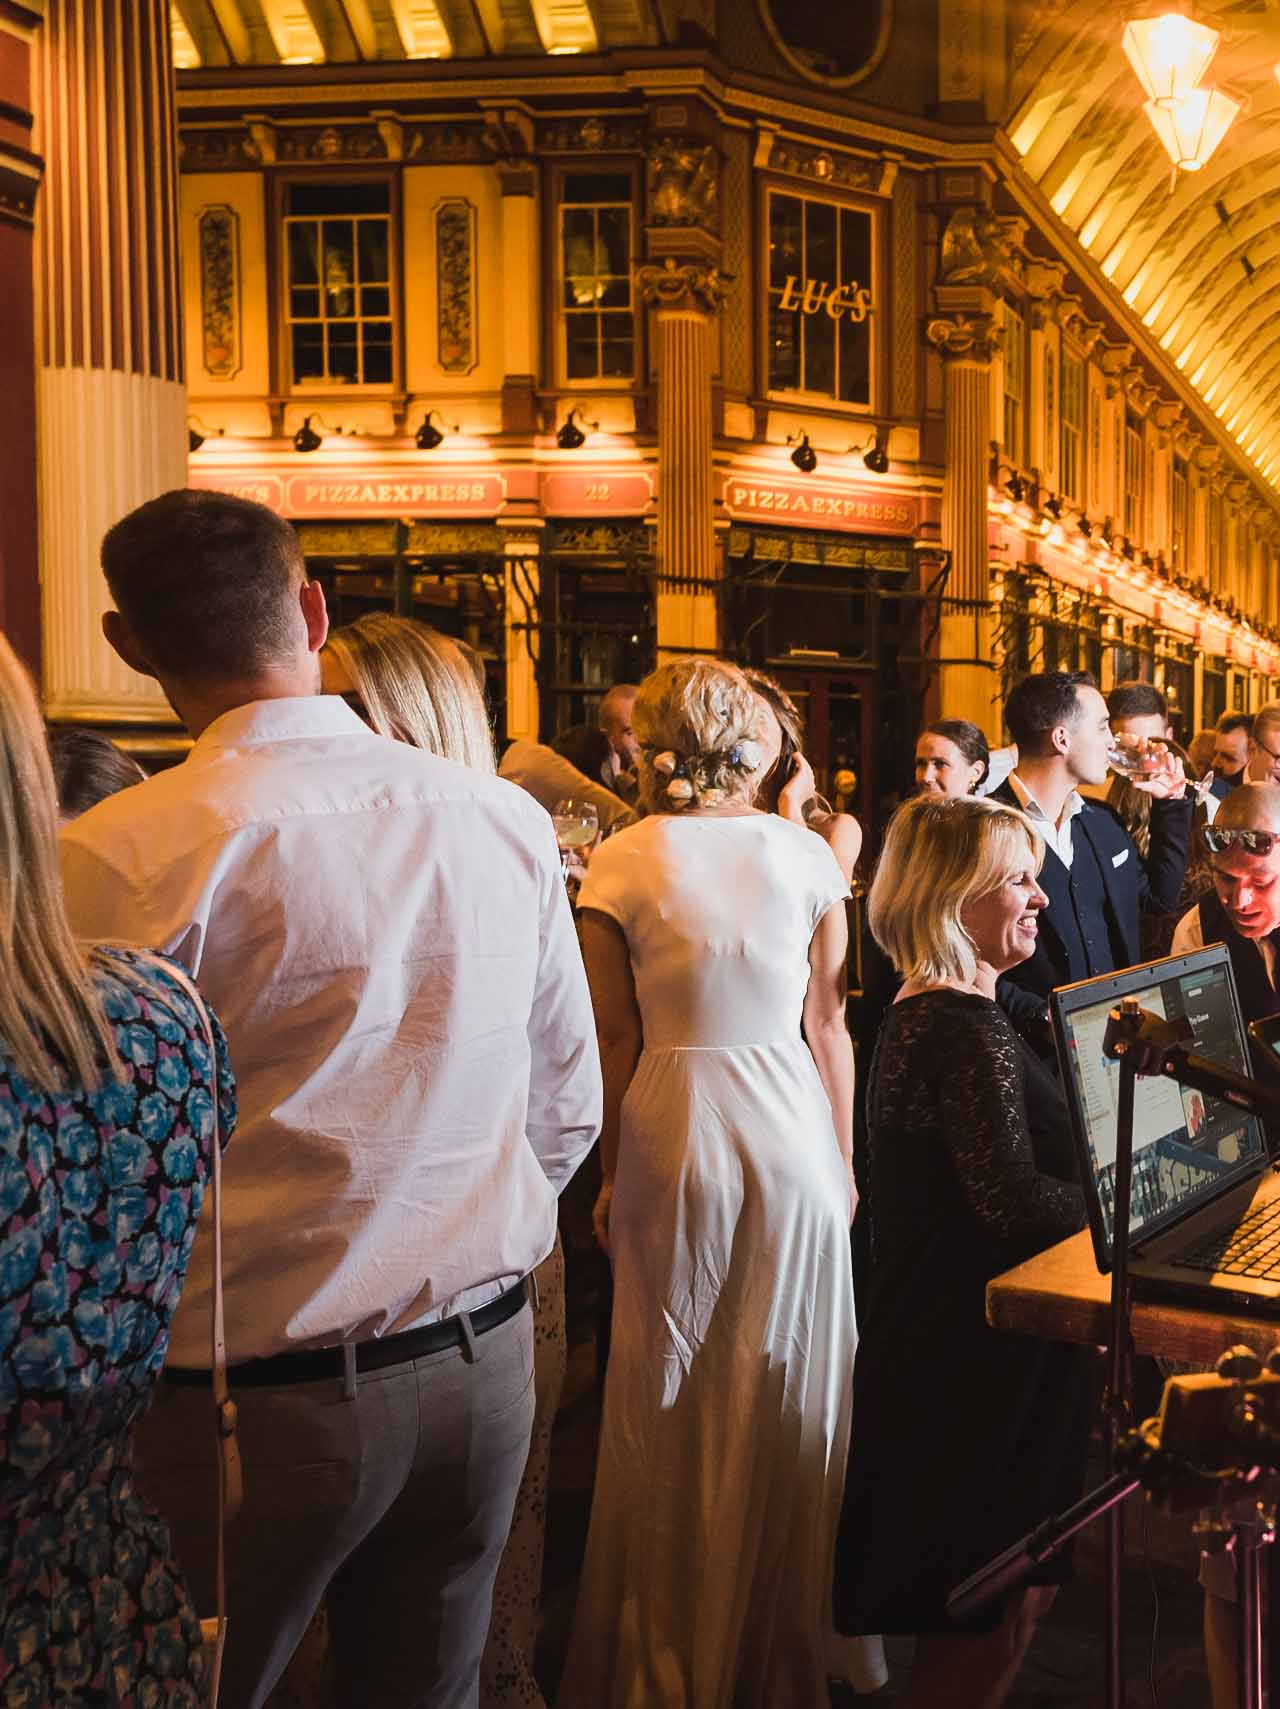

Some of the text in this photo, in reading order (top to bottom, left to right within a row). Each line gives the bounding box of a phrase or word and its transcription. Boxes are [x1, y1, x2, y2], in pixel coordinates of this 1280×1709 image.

[778, 275, 870, 322] LUC'S
[305, 483, 486, 503] PIZZAEXPRESS
[586, 483, 610, 501] 22
[733, 488, 909, 522] PIZZAEXPRESS
